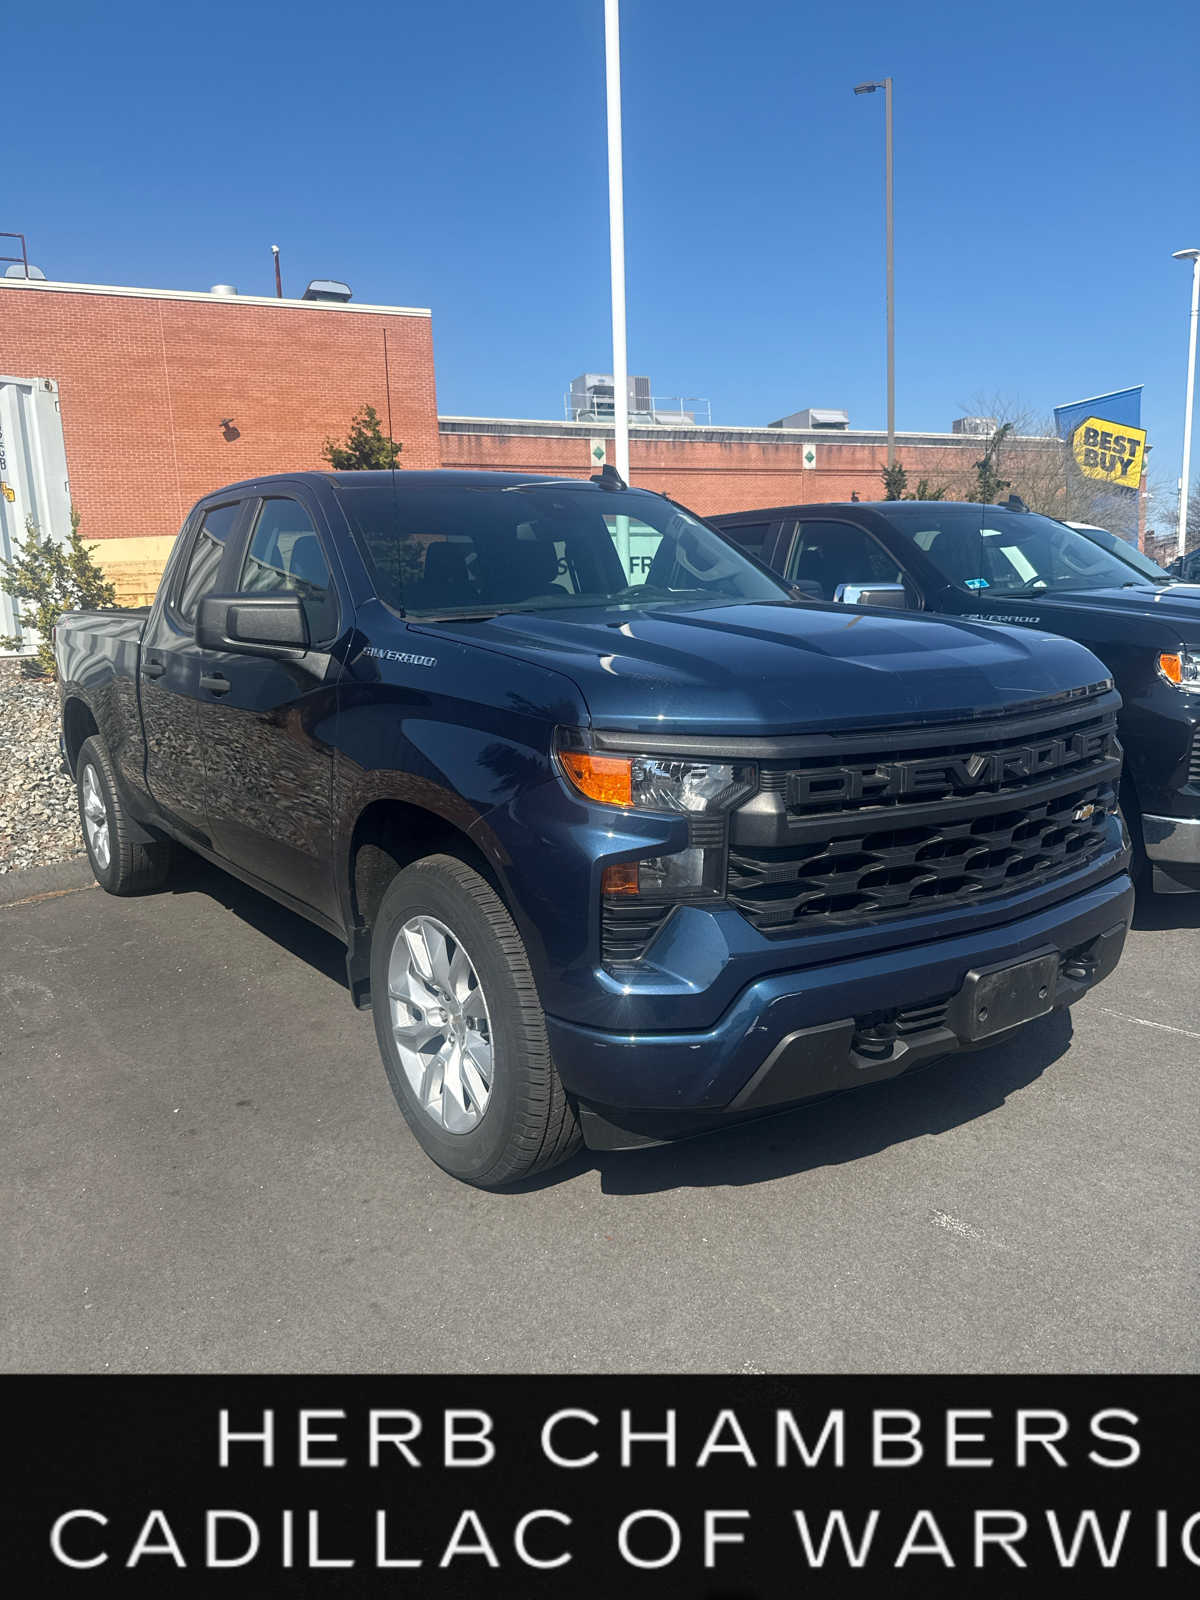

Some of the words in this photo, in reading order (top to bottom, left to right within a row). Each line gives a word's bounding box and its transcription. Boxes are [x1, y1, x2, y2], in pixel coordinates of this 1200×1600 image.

[1084, 427, 1141, 457] BEST
[1084, 448, 1134, 475] BUY
[362, 647, 437, 667] SILVERADO
